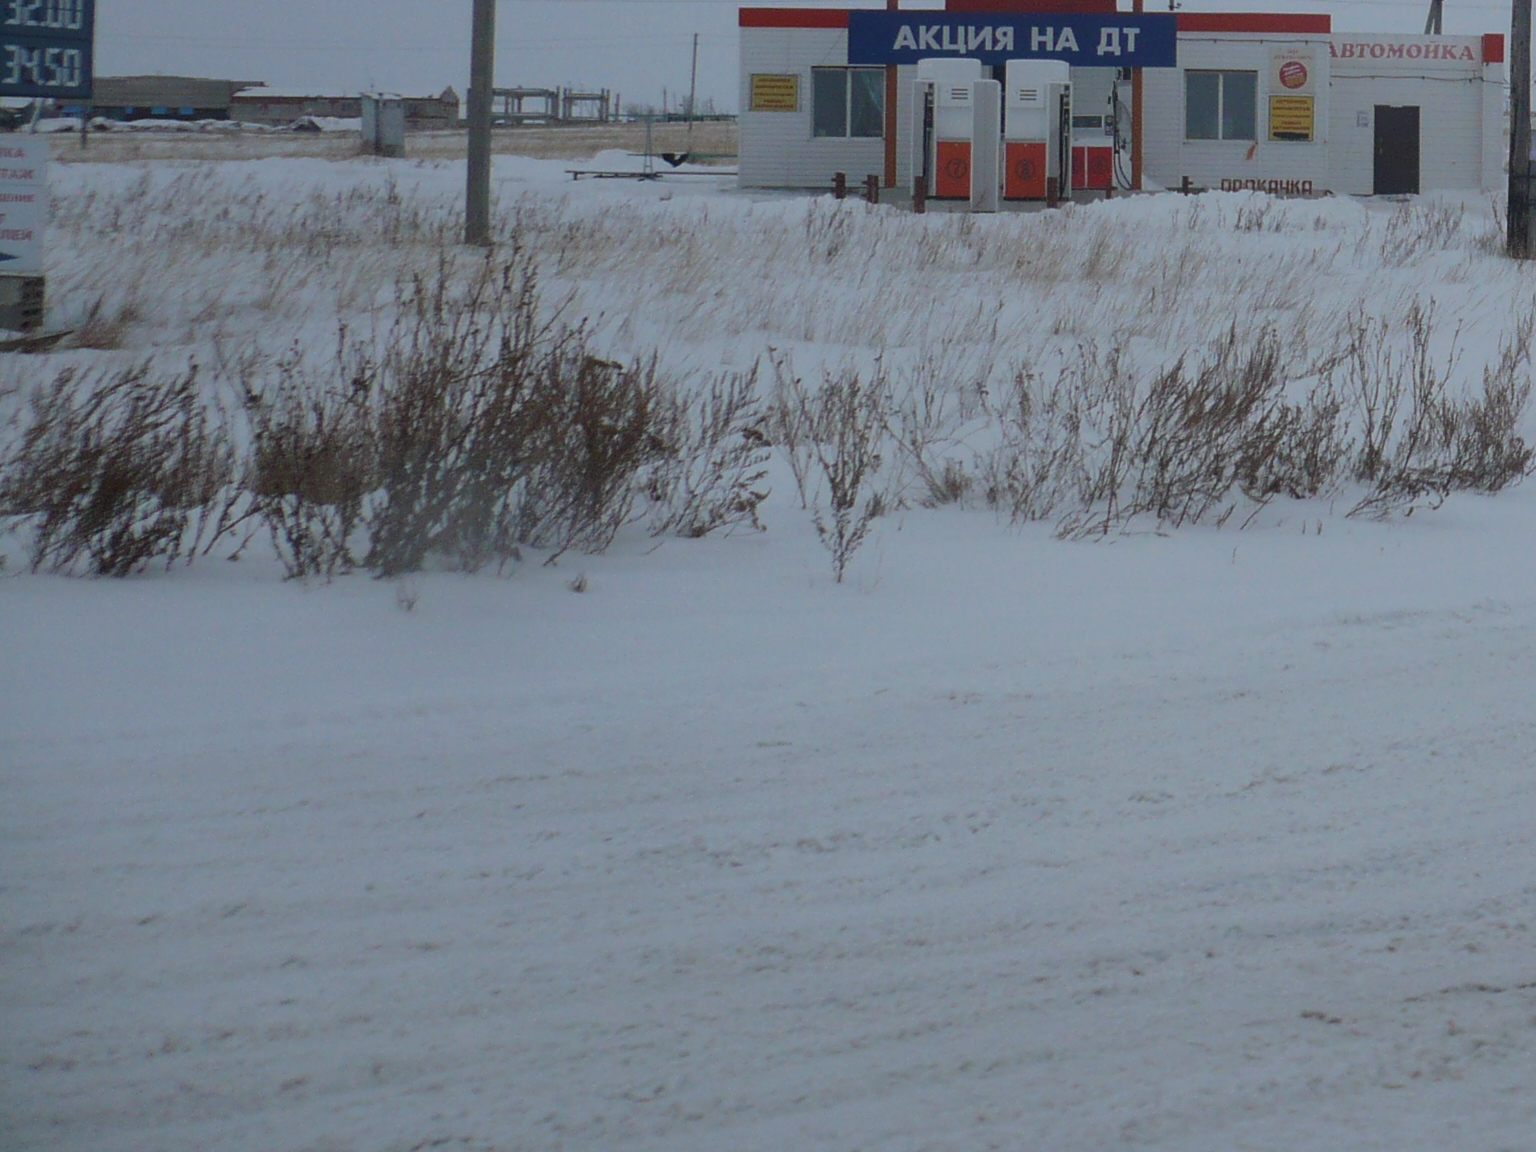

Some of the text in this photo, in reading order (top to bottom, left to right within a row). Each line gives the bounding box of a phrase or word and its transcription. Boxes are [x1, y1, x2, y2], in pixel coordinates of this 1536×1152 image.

[893, 25, 1140, 56] АКЦИЯ НА ДТ
[2, 44, 81, 88] 34.50
